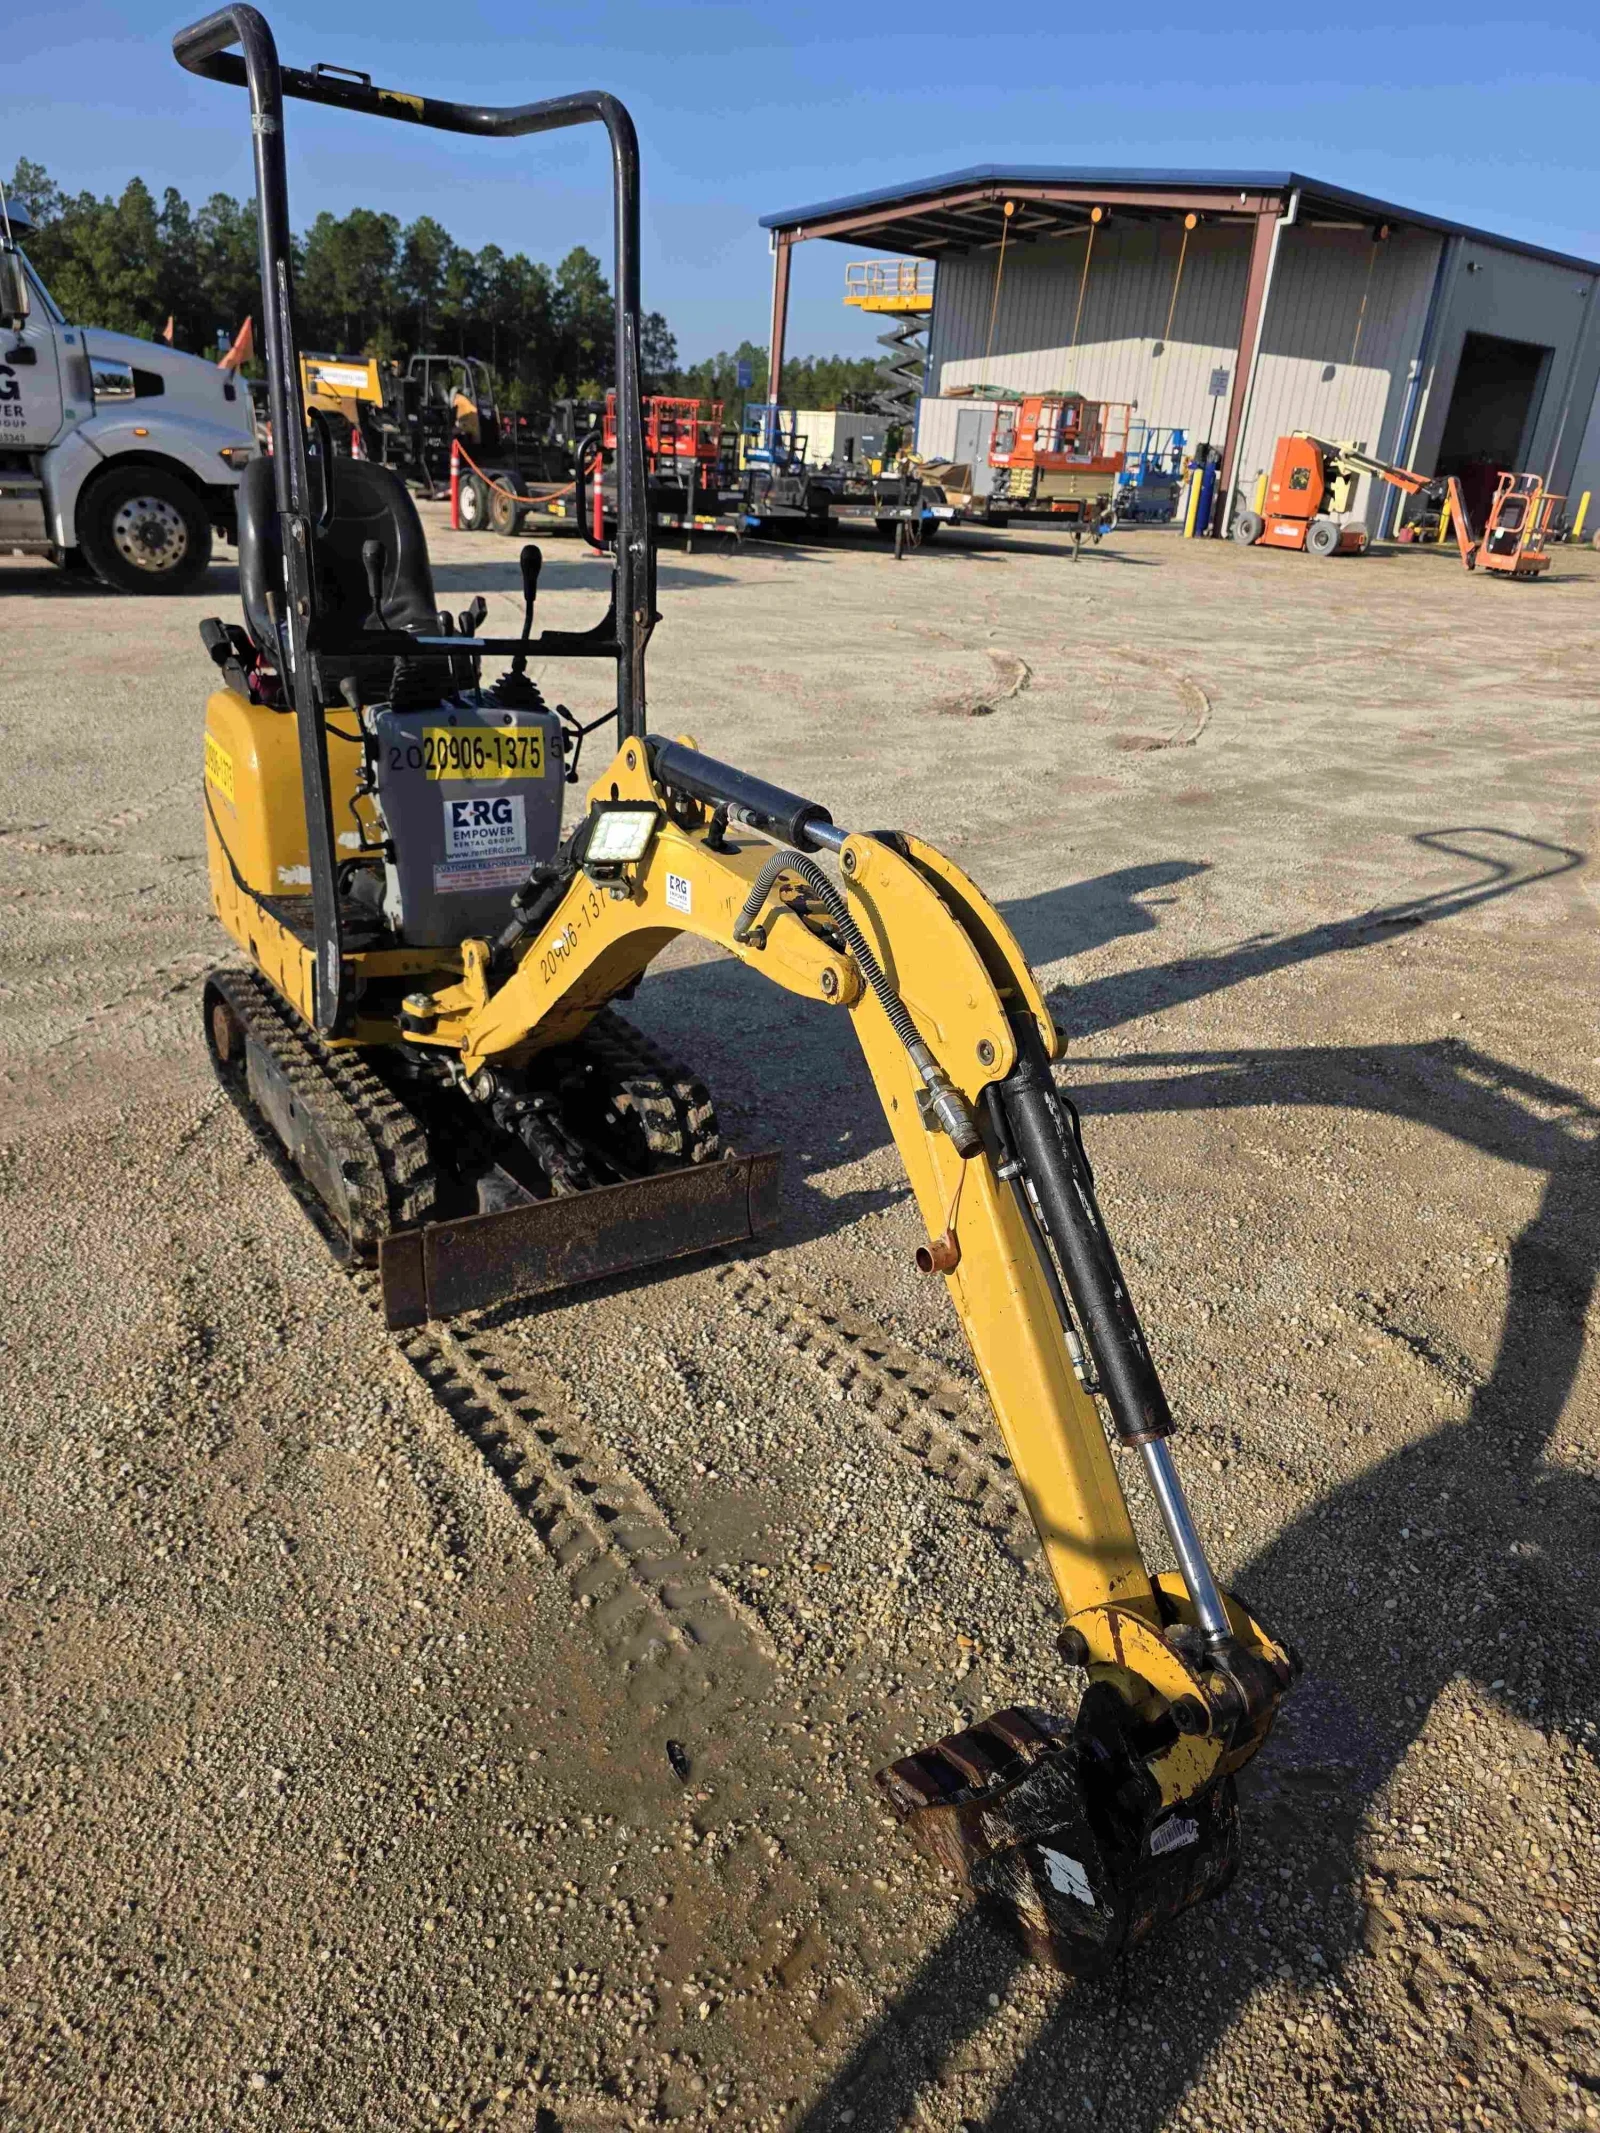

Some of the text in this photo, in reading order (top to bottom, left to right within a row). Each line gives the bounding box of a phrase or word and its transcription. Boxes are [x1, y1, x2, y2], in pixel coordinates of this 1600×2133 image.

[424, 736, 541, 770] 20906-1375
[452, 798, 513, 828] ERG
[453, 826, 514, 841] EMPOWER
[453, 836, 516, 848] RENTAL GROUP
[447, 846, 523, 859] www.rentERG.com
[669, 874, 687, 894] ERG
